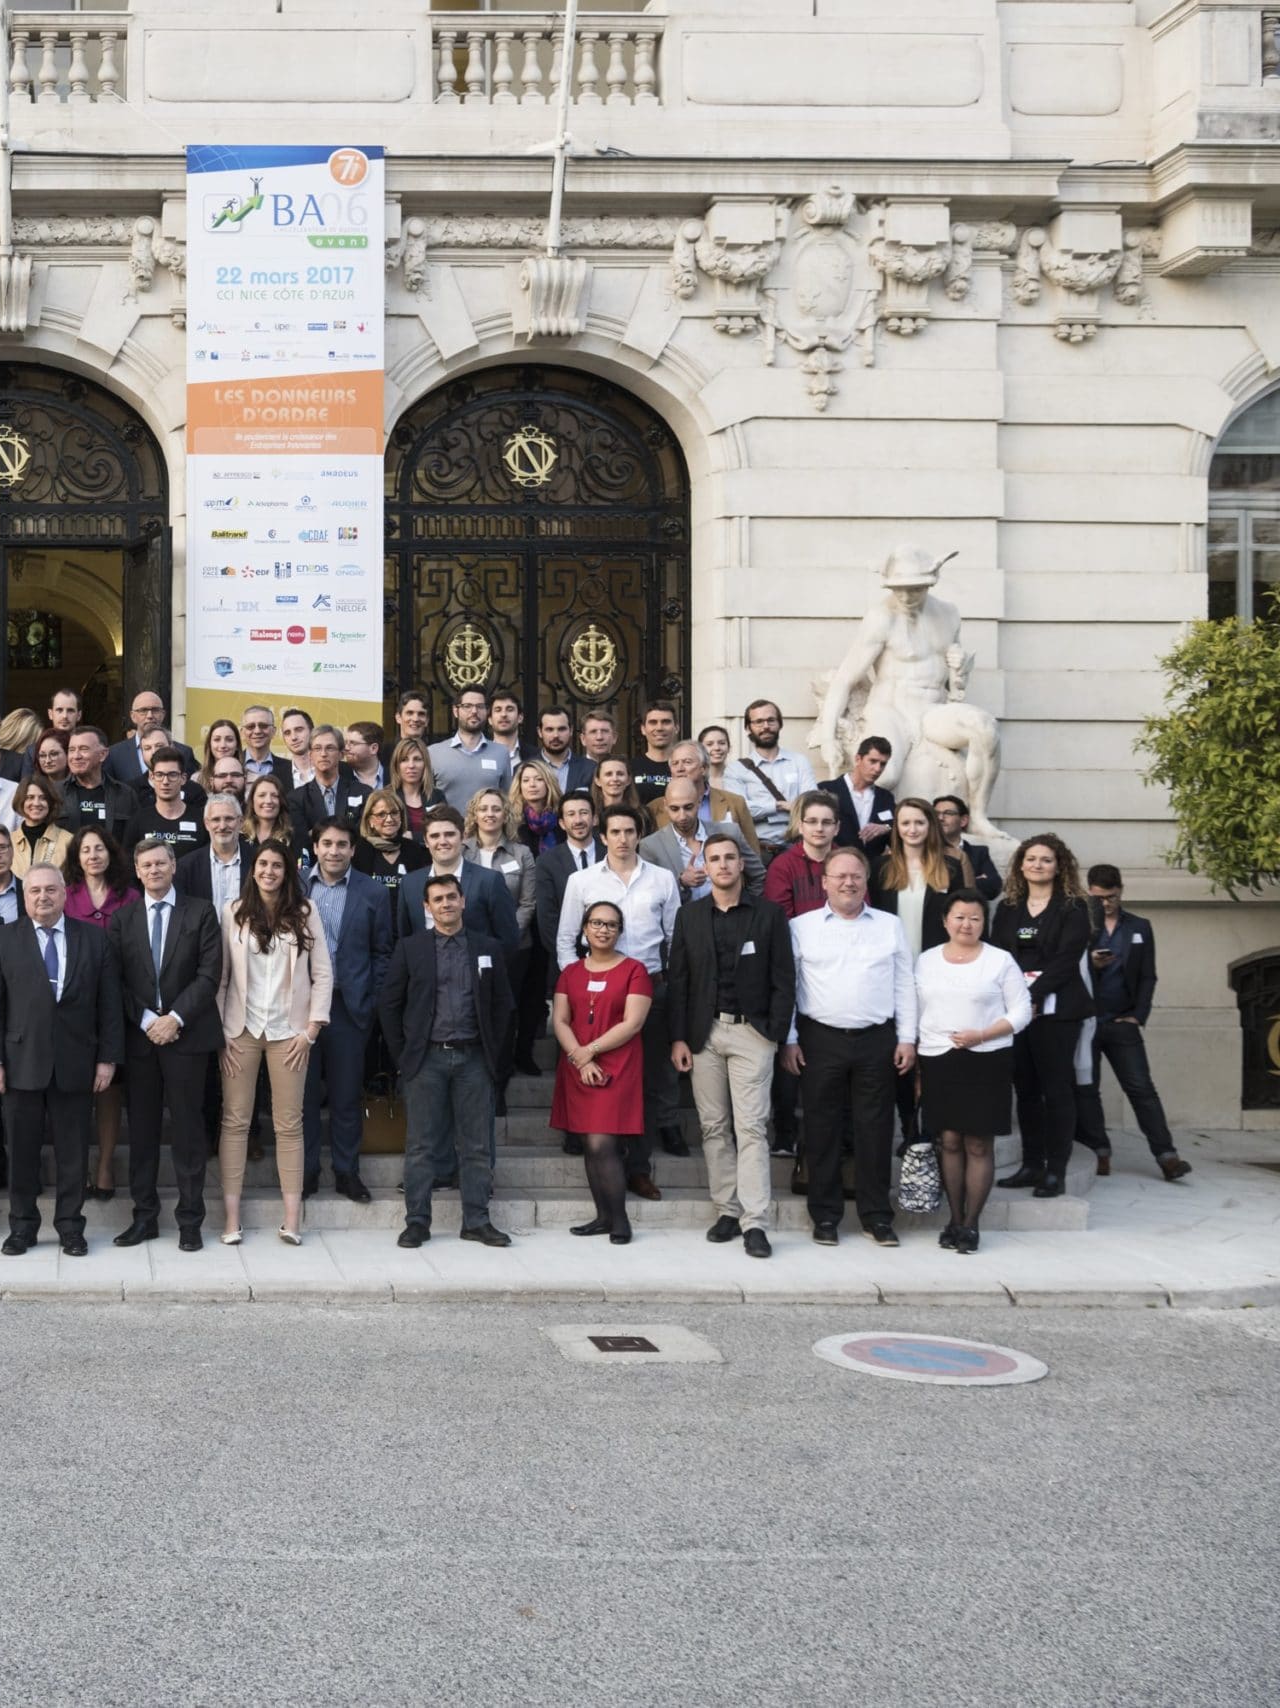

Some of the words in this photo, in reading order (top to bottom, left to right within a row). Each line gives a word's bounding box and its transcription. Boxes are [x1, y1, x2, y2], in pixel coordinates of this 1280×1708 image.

[269, 192, 368, 227] BA06
[215, 266, 242, 285] 22
[250, 271, 299, 285] mars
[306, 266, 354, 285] 2017
[216, 289, 234, 301] CCI
[239, 289, 268, 301] NICE
[272, 286, 304, 301] CÔTE
[310, 289, 355, 301] D'AZUR
[214, 388, 245, 404] LES
[251, 388, 357, 404] DONNEURS
[242, 406, 329, 422] D'ORDRE
